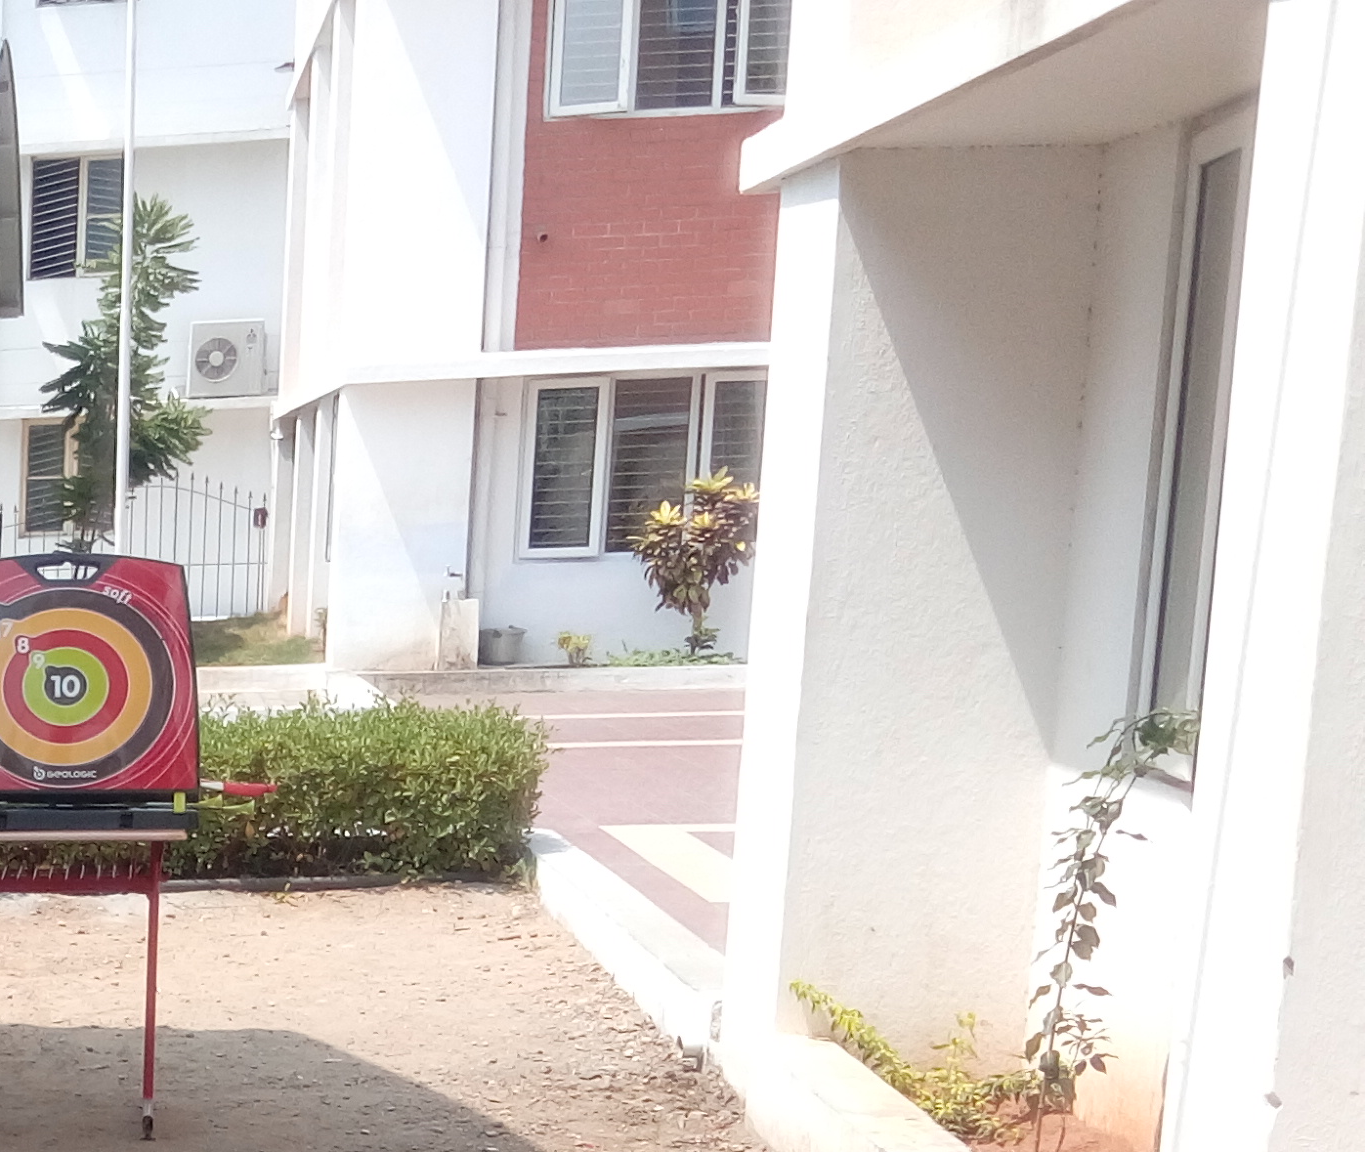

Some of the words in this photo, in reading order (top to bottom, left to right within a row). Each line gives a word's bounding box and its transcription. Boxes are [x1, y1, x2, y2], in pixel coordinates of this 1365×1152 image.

[102, 585, 133, 605] soft
[1, 622, 13, 638] 7
[16, 636, 30, 654] 8
[32, 652, 46, 670] 9
[50, 675, 81, 698] 10
